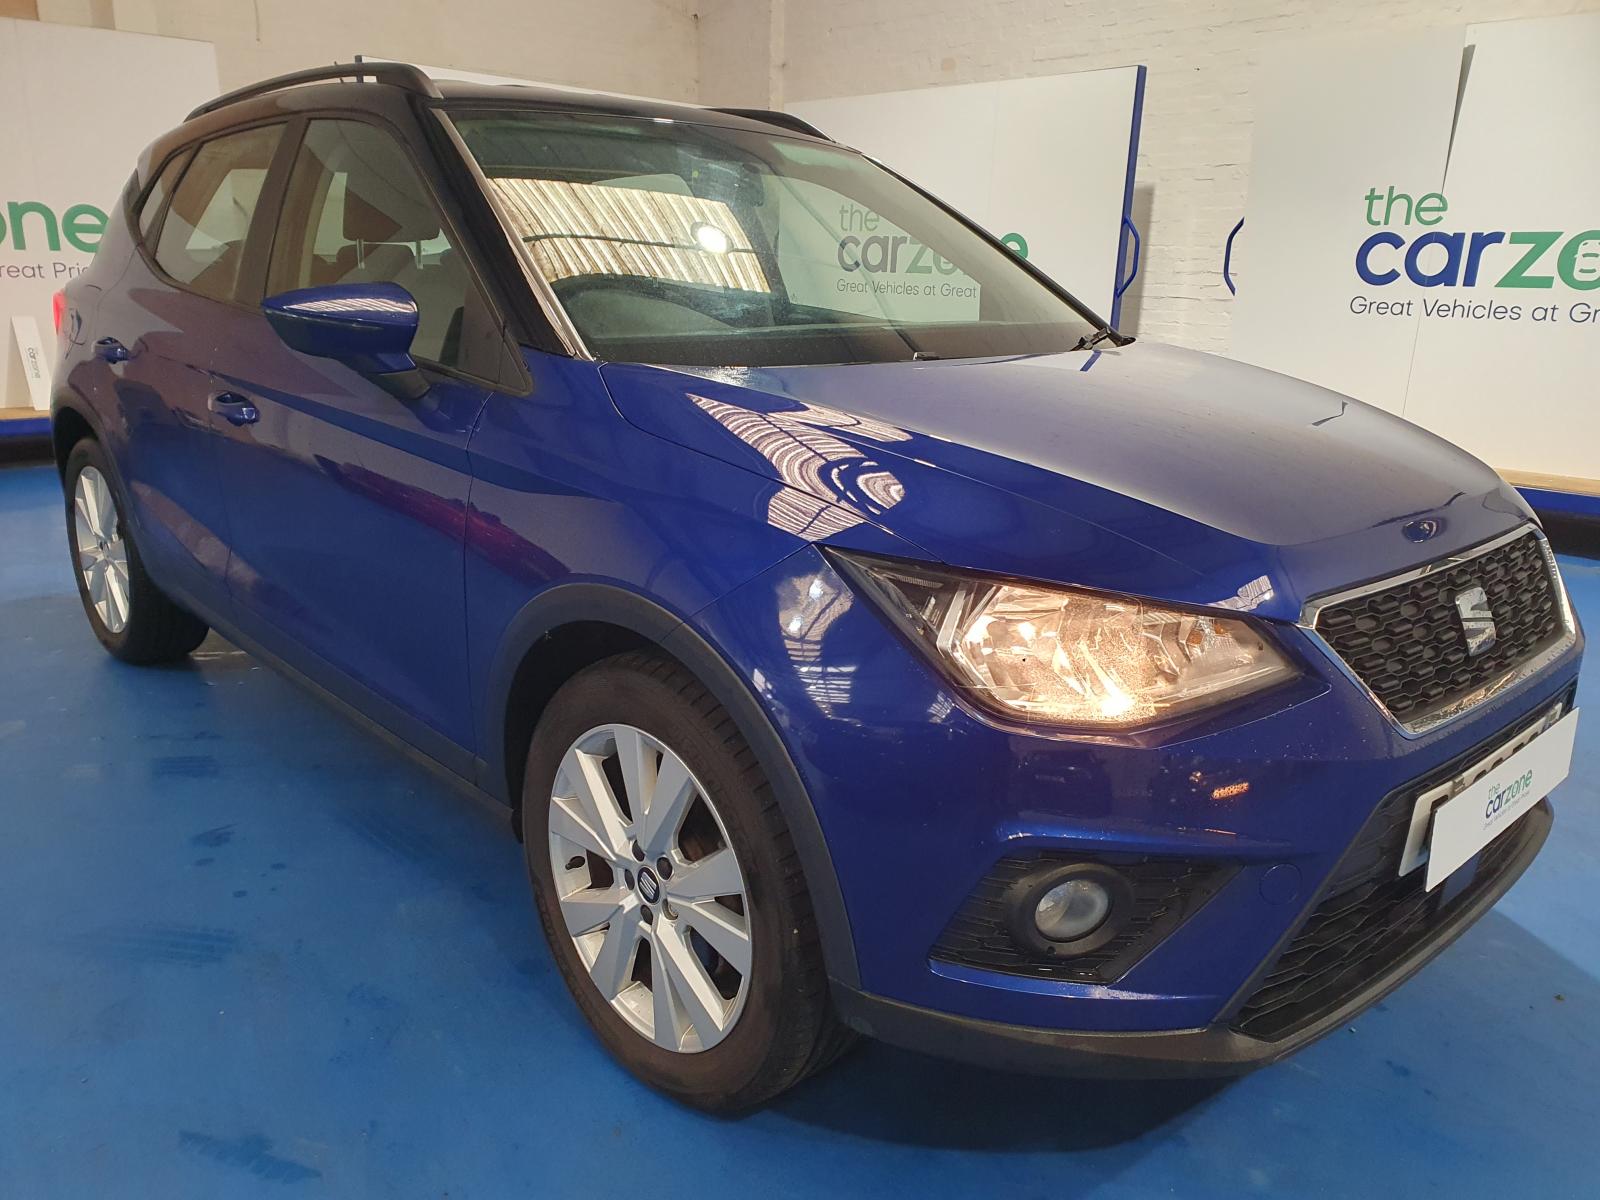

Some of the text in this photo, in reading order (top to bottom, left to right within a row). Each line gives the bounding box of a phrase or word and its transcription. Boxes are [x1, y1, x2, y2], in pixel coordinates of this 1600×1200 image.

[839, 203, 880, 232] the
[1364, 185, 1448, 226] the
[0, 201, 109, 253] ne
[836, 278, 977, 299] Great Vehicles at Great
[1350, 295, 1413, 317] Great
[1423, 298, 1522, 322] Vehicles
[1531, 303, 1559, 322] at
[1486, 769, 1533, 819] carzone
